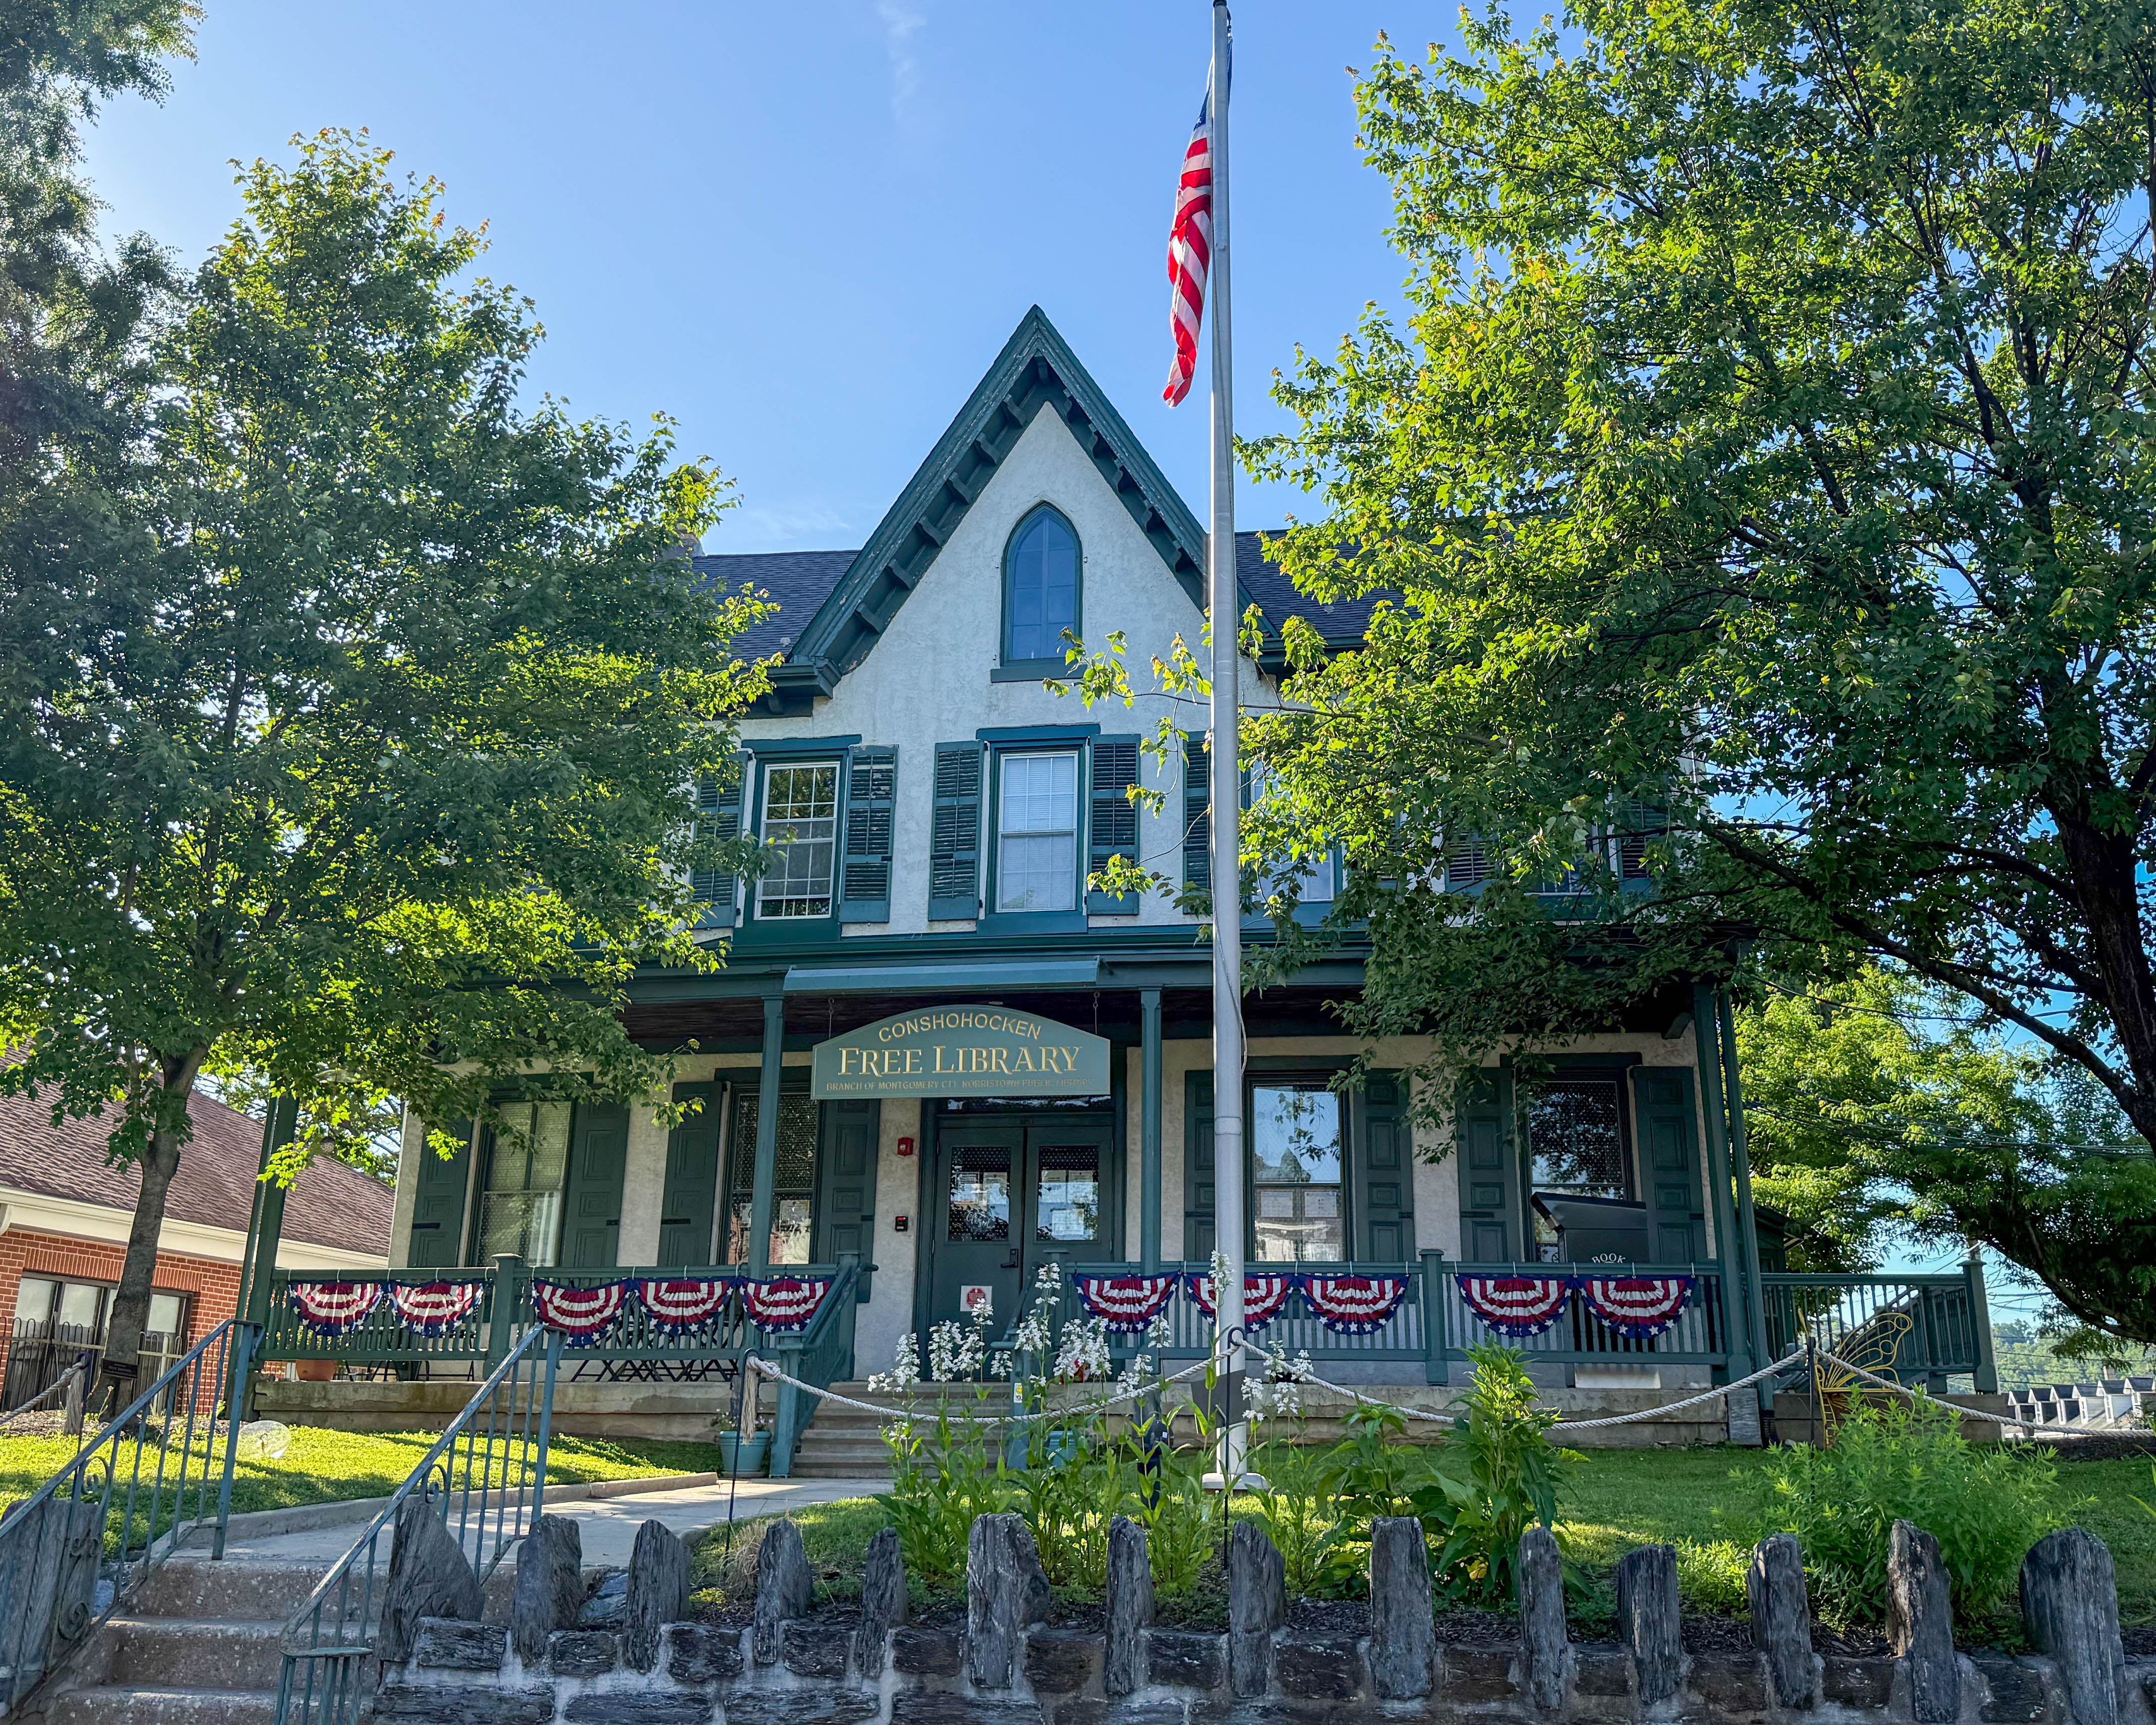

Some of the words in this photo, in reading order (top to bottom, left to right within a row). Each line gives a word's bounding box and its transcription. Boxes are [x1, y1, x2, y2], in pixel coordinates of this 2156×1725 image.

[879, 1013, 1041, 1042] CONSHOHOCKEN
[838, 1048, 923, 1077] FREE
[933, 1045, 1082, 1075] LIBRARY
[827, 1083, 862, 1091] BRANCH
[879, 1081, 939, 1090] MONTGOMERY
[962, 1079, 1020, 1088] NORRISTOWN
[1592, 1253, 1626, 1263] BOOK
